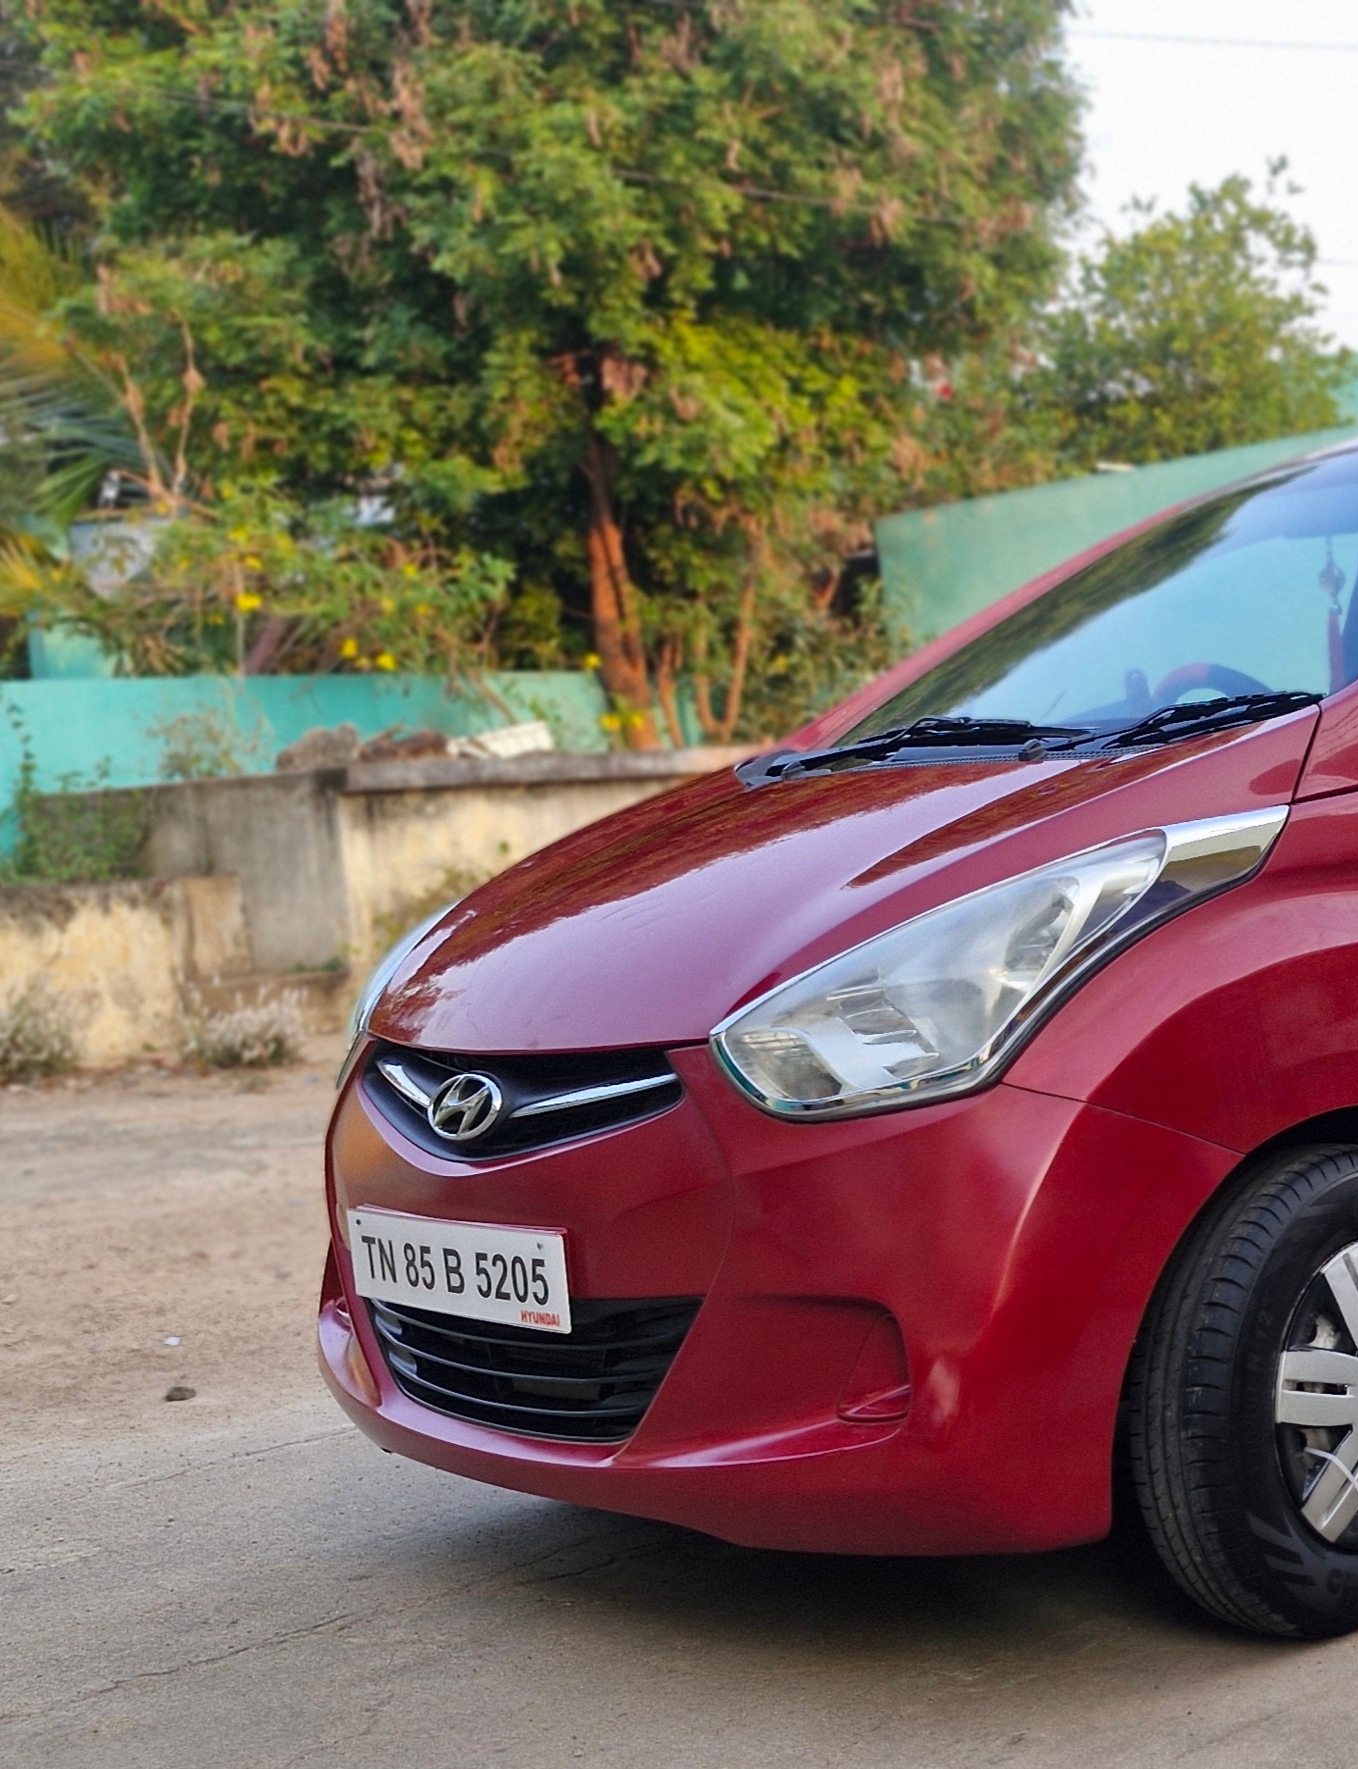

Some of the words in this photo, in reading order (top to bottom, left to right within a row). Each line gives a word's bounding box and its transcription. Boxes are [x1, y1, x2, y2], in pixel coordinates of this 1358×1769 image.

[361, 1235, 398, 1284] TN
[403, 1242, 436, 1291] 85
[442, 1247, 465, 1294] B
[474, 1251, 550, 1306] 5205
[520, 1309, 561, 1327] HYUNDAI
